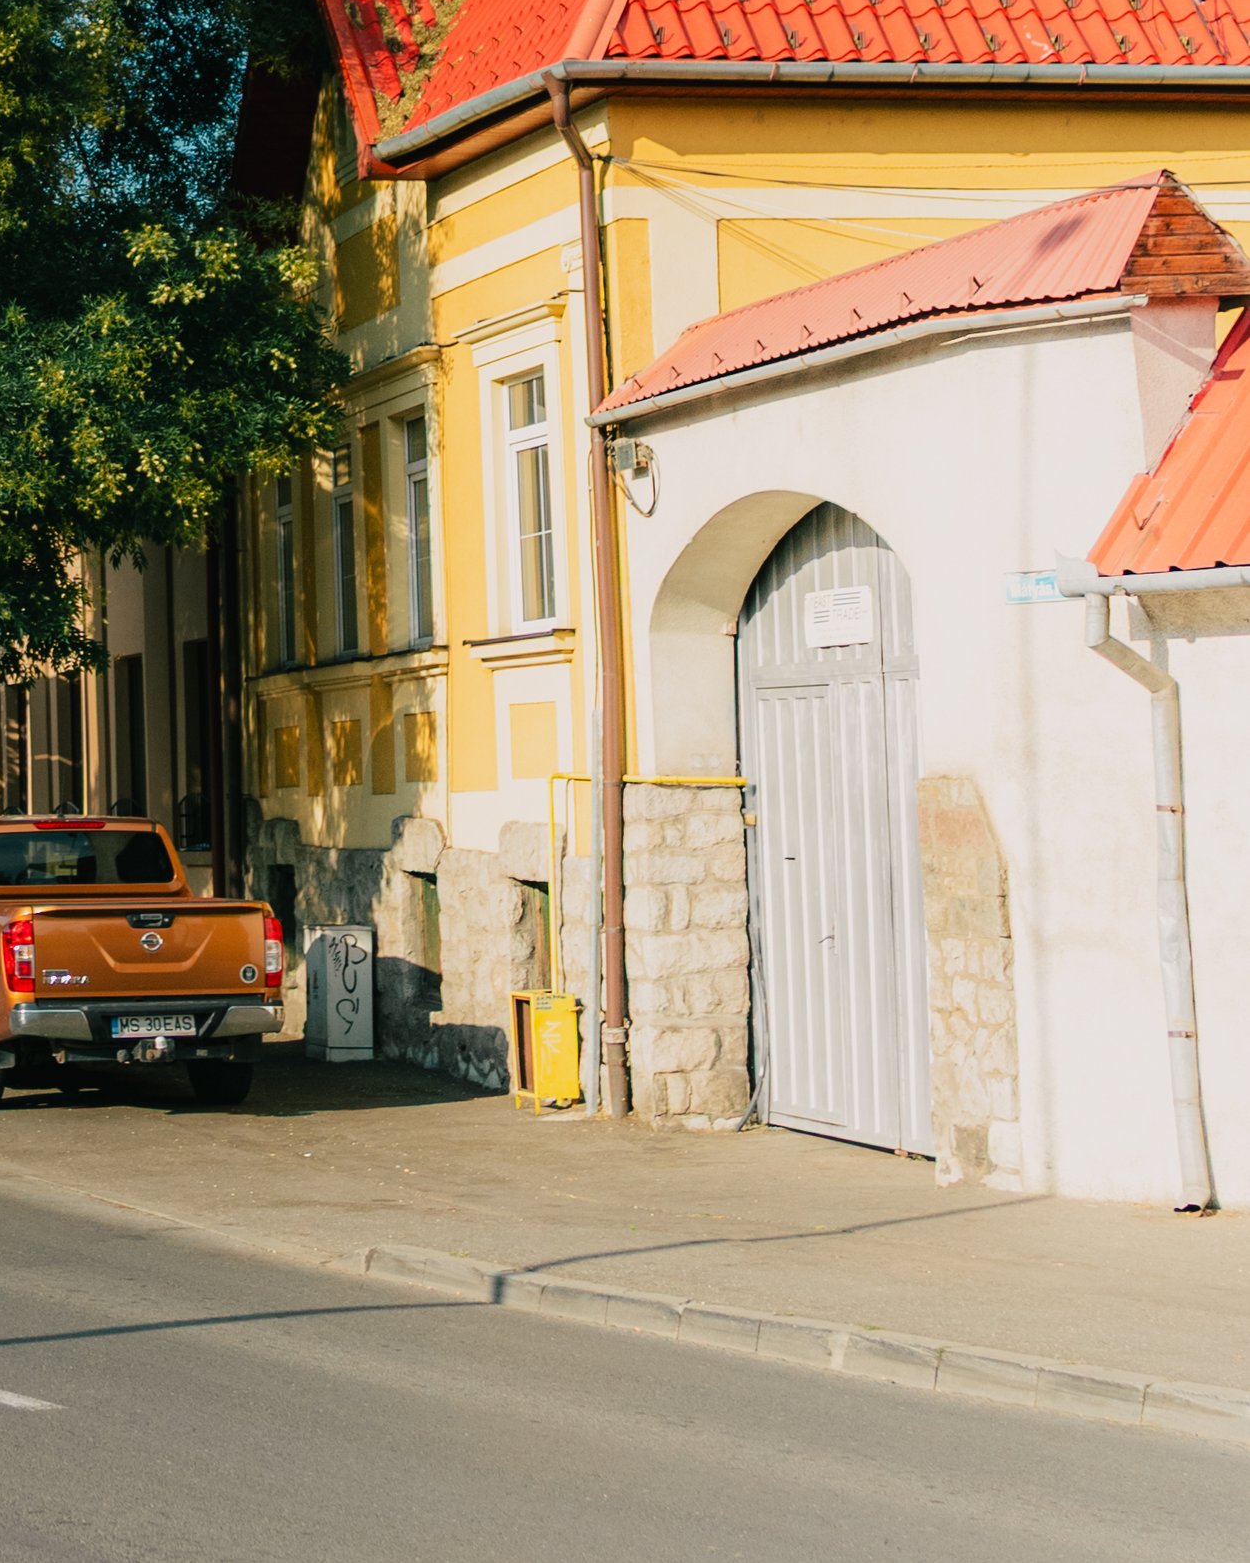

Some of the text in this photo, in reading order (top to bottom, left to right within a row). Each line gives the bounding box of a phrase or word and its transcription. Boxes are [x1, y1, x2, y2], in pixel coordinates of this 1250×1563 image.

[814, 594, 831, 609] EAST
[832, 607, 862, 622] TRADE
[119, 1017, 140, 1033] MS
